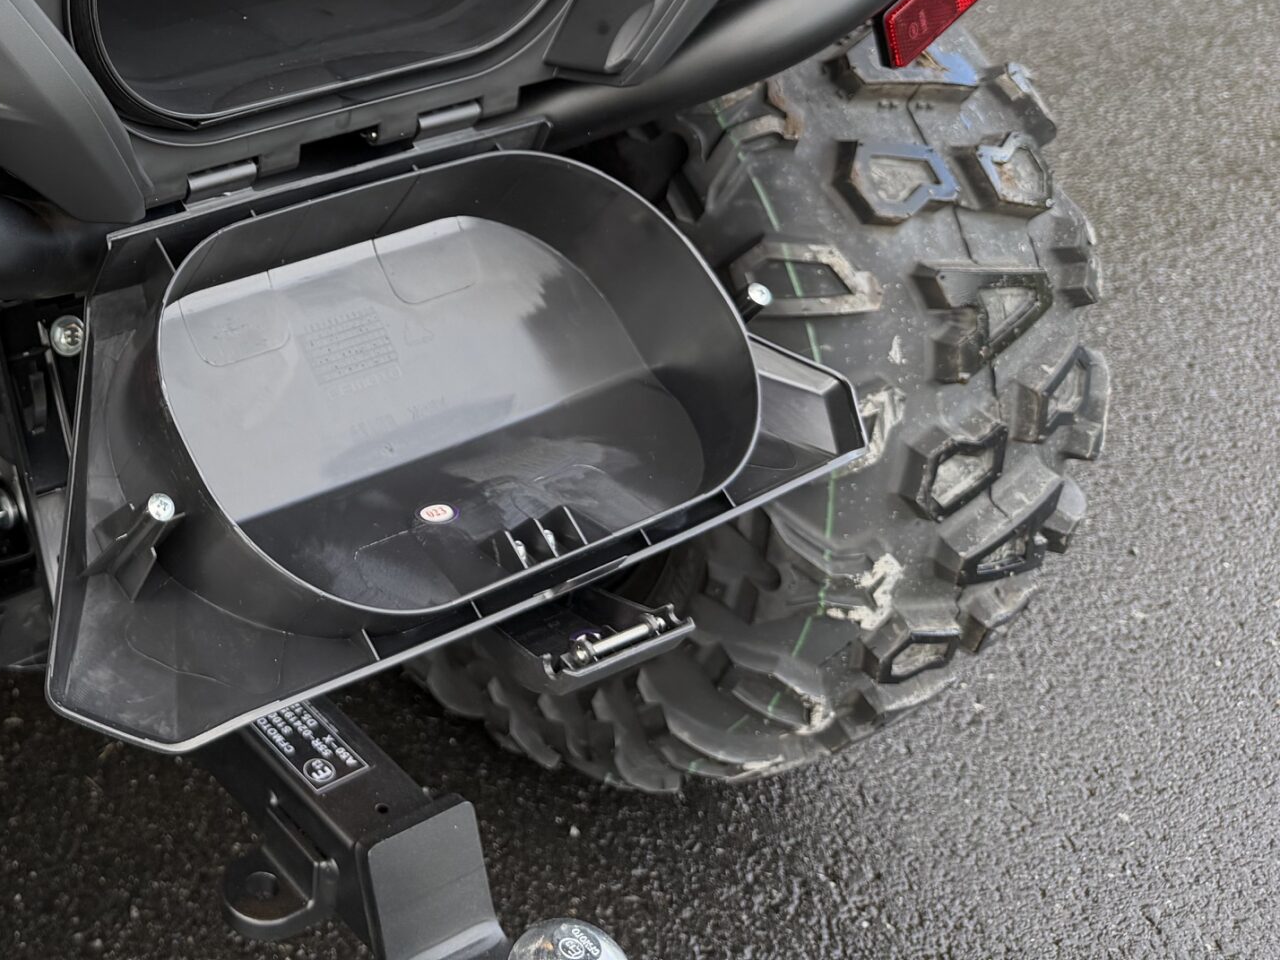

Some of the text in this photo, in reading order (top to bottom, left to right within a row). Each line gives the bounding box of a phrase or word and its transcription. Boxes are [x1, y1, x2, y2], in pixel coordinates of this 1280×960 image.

[256, 716, 295, 755] CFMOTO
[322, 734, 358, 766] A50-X
[571, 928, 600, 956] CFMOTO
